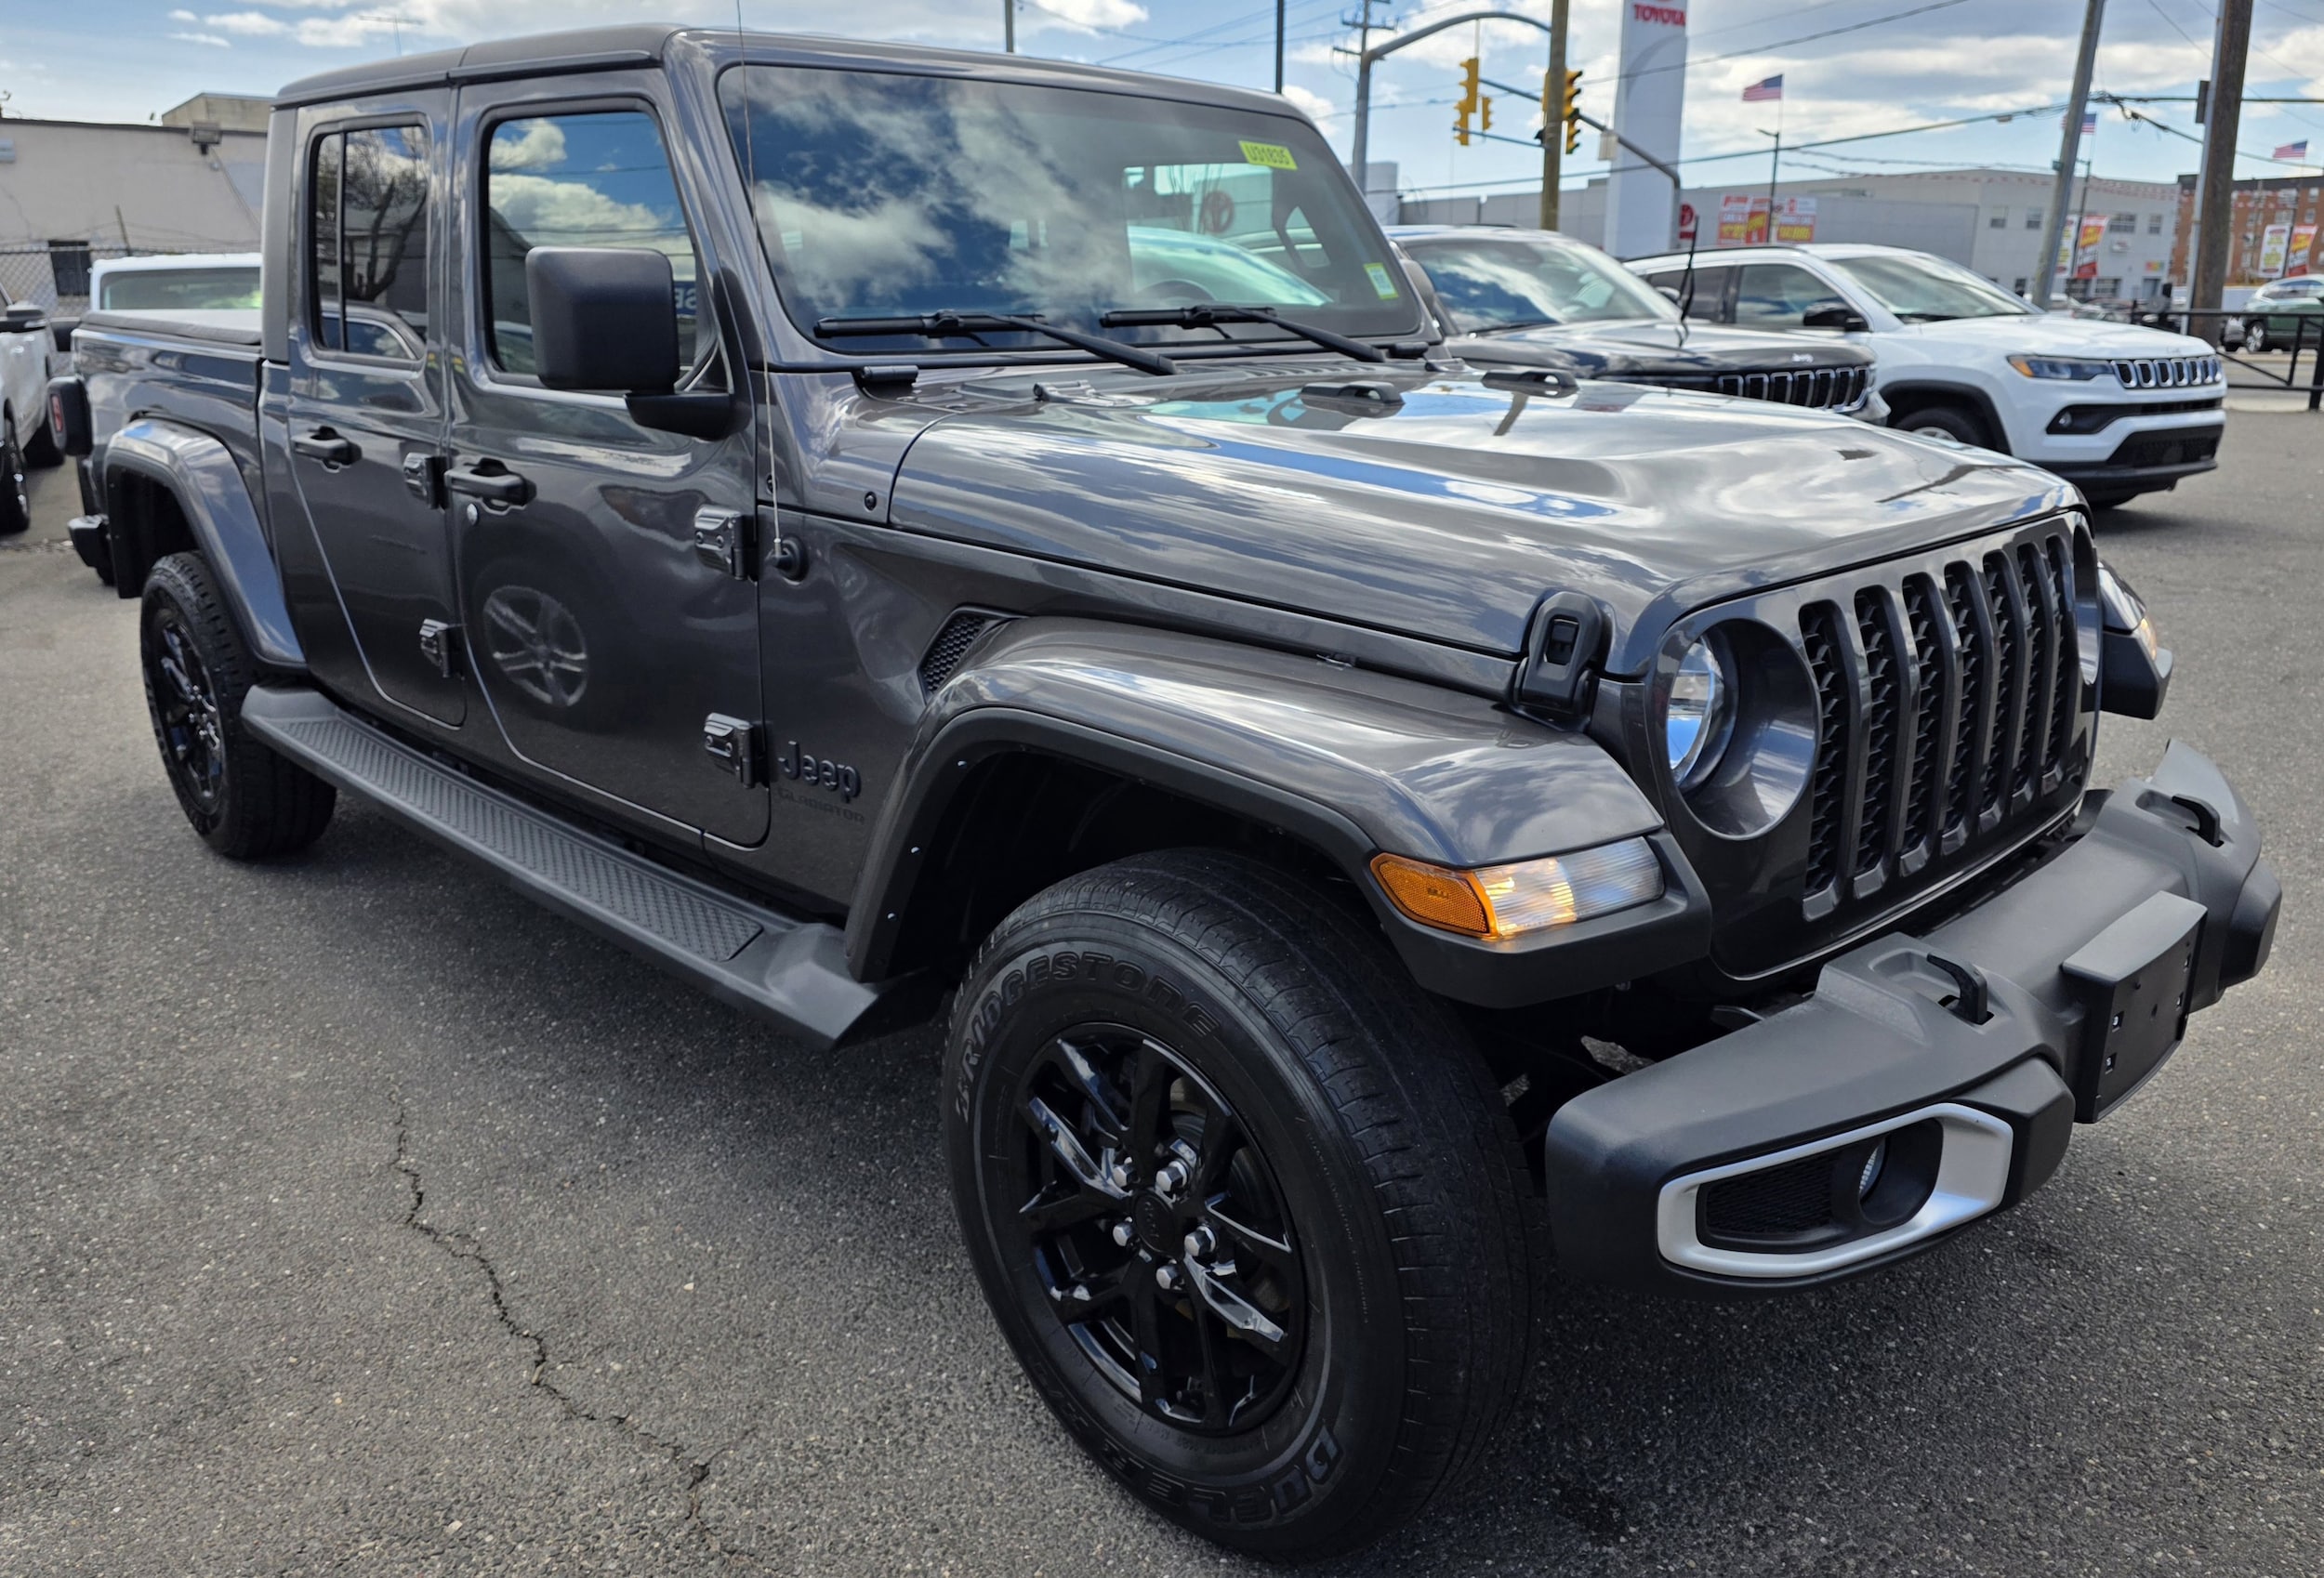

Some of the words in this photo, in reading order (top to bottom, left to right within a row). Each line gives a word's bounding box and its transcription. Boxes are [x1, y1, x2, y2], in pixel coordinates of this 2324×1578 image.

[1633, 4, 1686, 26] TOYOTA
[778, 741, 862, 804] Jeep
[777, 786, 865, 824] GLADIATOR
[955, 951, 1221, 1124] BRIDGESTONE
